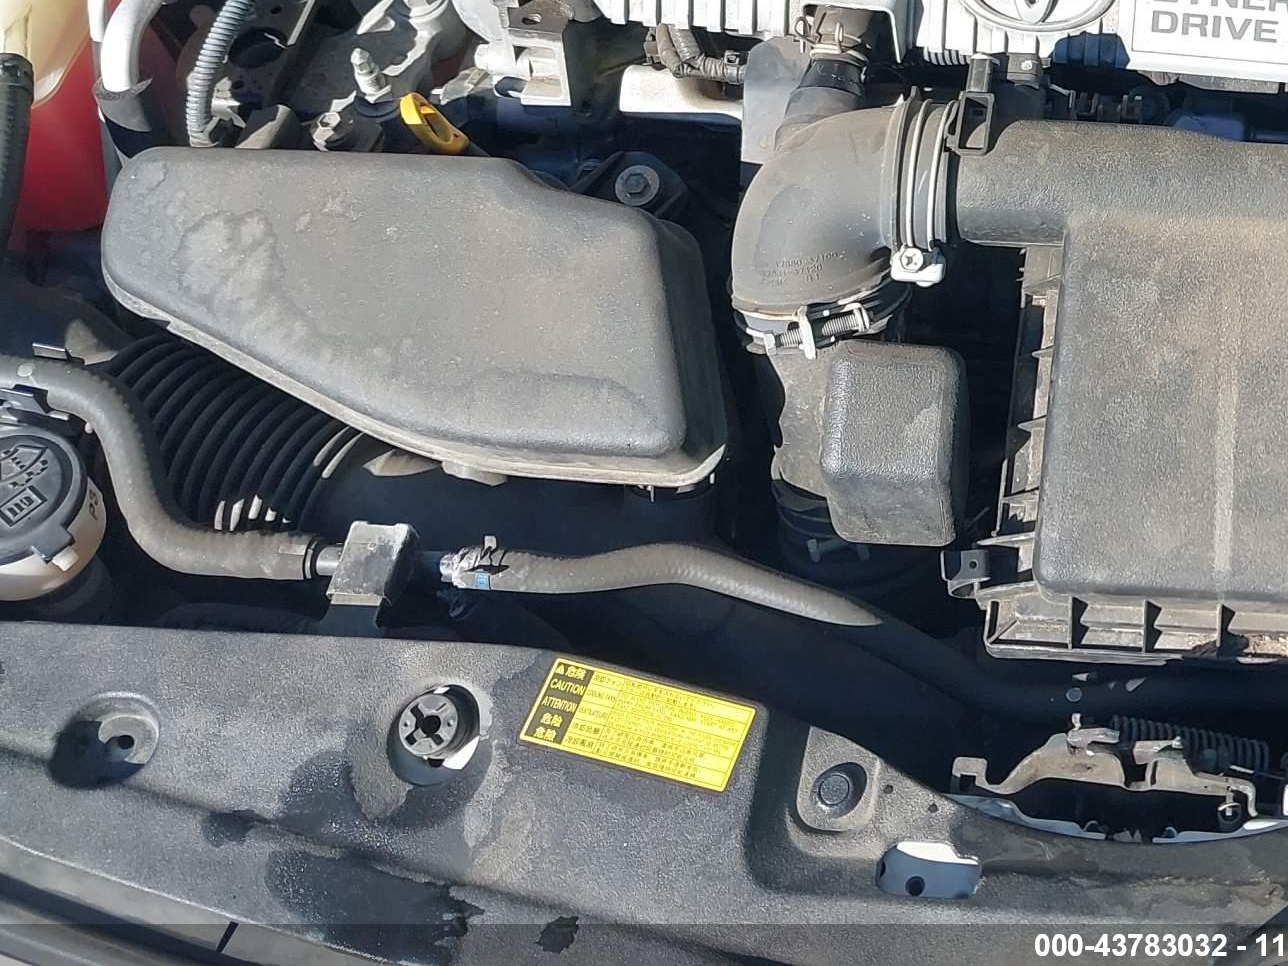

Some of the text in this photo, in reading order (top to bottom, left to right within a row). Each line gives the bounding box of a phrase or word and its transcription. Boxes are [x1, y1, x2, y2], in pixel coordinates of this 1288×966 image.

[1151, 10, 1279, 43] DRIVE
[550, 677, 586, 696] CAUTION
[541, 695, 578, 714] ATTENTION
